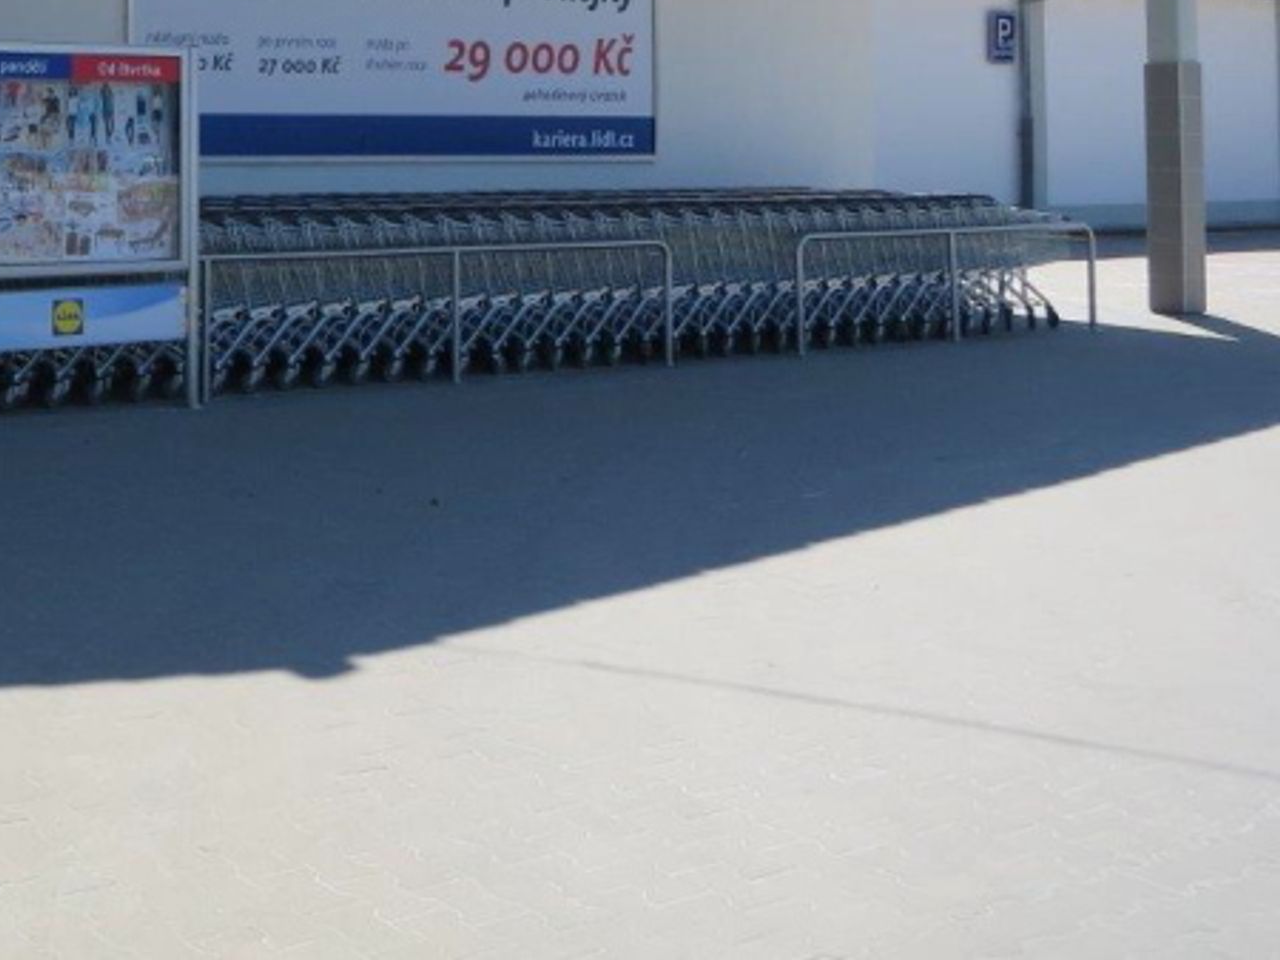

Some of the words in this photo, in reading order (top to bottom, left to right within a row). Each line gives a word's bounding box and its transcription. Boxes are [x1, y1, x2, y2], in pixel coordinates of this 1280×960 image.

[998, 18, 1011, 47] P
[212, 52, 234, 72] Kč
[321, 55, 341, 74] Kč
[444, 38, 491, 82] 29
[593, 33, 635, 77] Kč
[531, 129, 635, 148] kariera.lidl.cz
